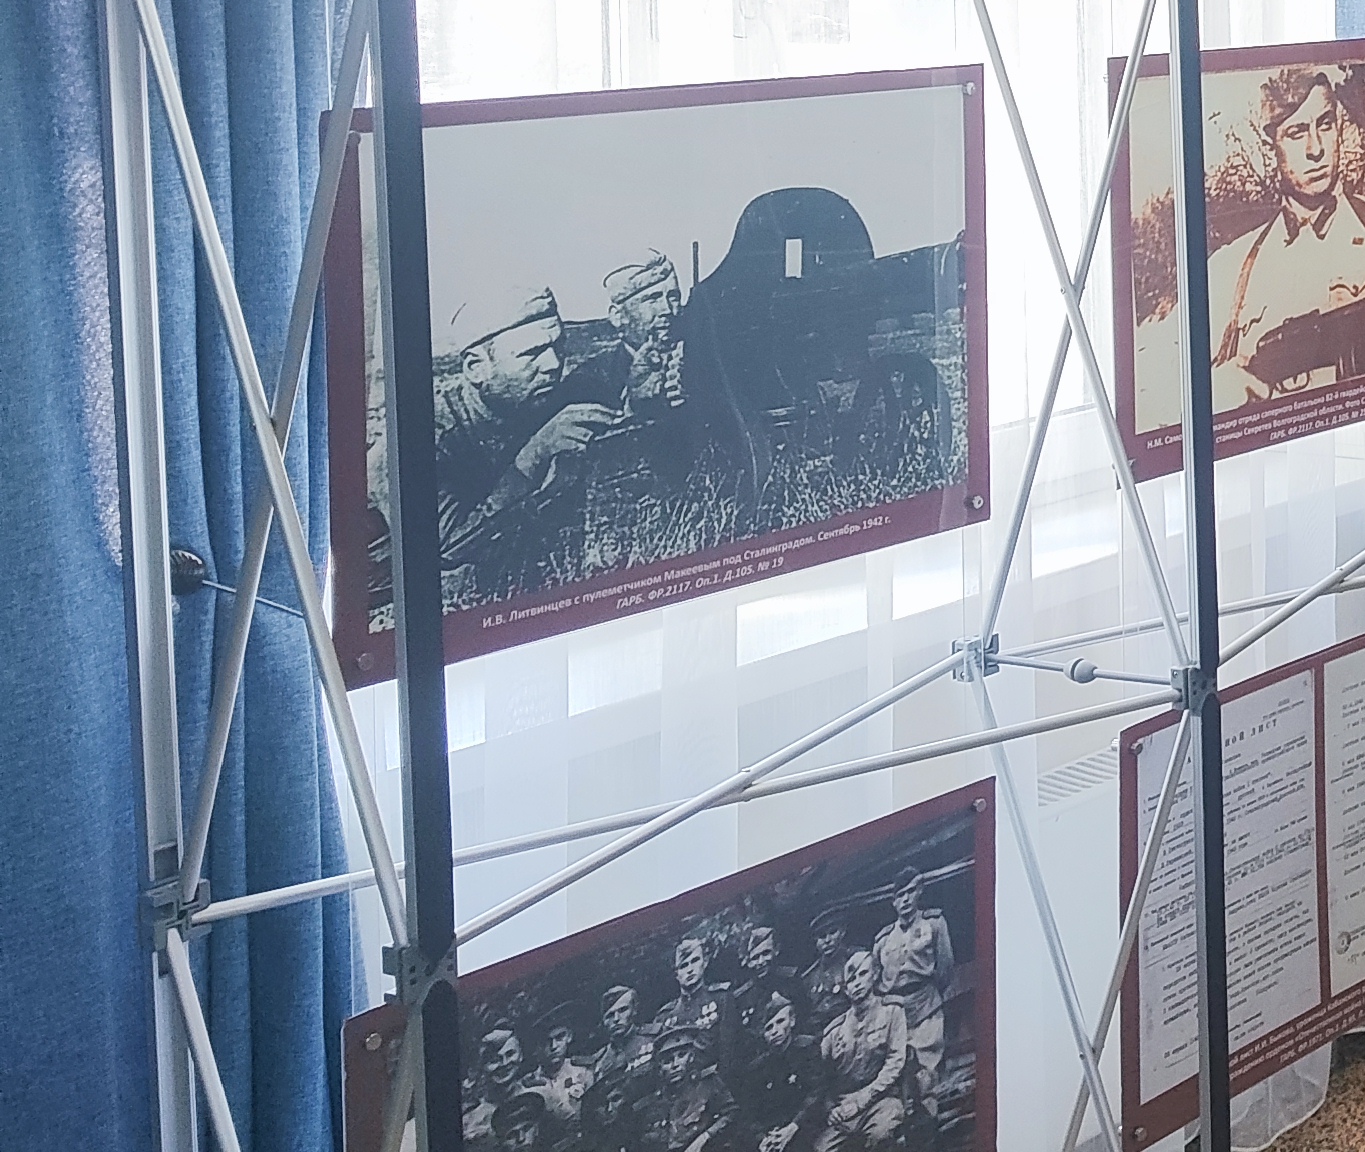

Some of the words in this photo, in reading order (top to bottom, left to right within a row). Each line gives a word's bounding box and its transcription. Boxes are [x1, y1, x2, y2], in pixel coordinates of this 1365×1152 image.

[481, 613, 507, 629] И.В.
[507, 597, 573, 623] Литвинцев
[573, 594, 581, 605] с
[581, 574, 663, 604] пулеметчиком
[662, 559, 722, 582] Макеевым
[721, 553, 743, 567] под
[742, 535, 817, 561] Сталинградом.
[816, 522, 862, 542] Сентябрь
[861, 515, 884, 531] 1942
[883, 515, 892, 525] г.
[615, 592, 646, 610] ГАРБ.
[646, 579, 693, 601] ФР.2117.
[694, 572, 722, 589] Оп.1.
[721, 563, 756, 584] Д.105.
[756, 560, 771, 572] №
[770, 555, 785, 569] 19
